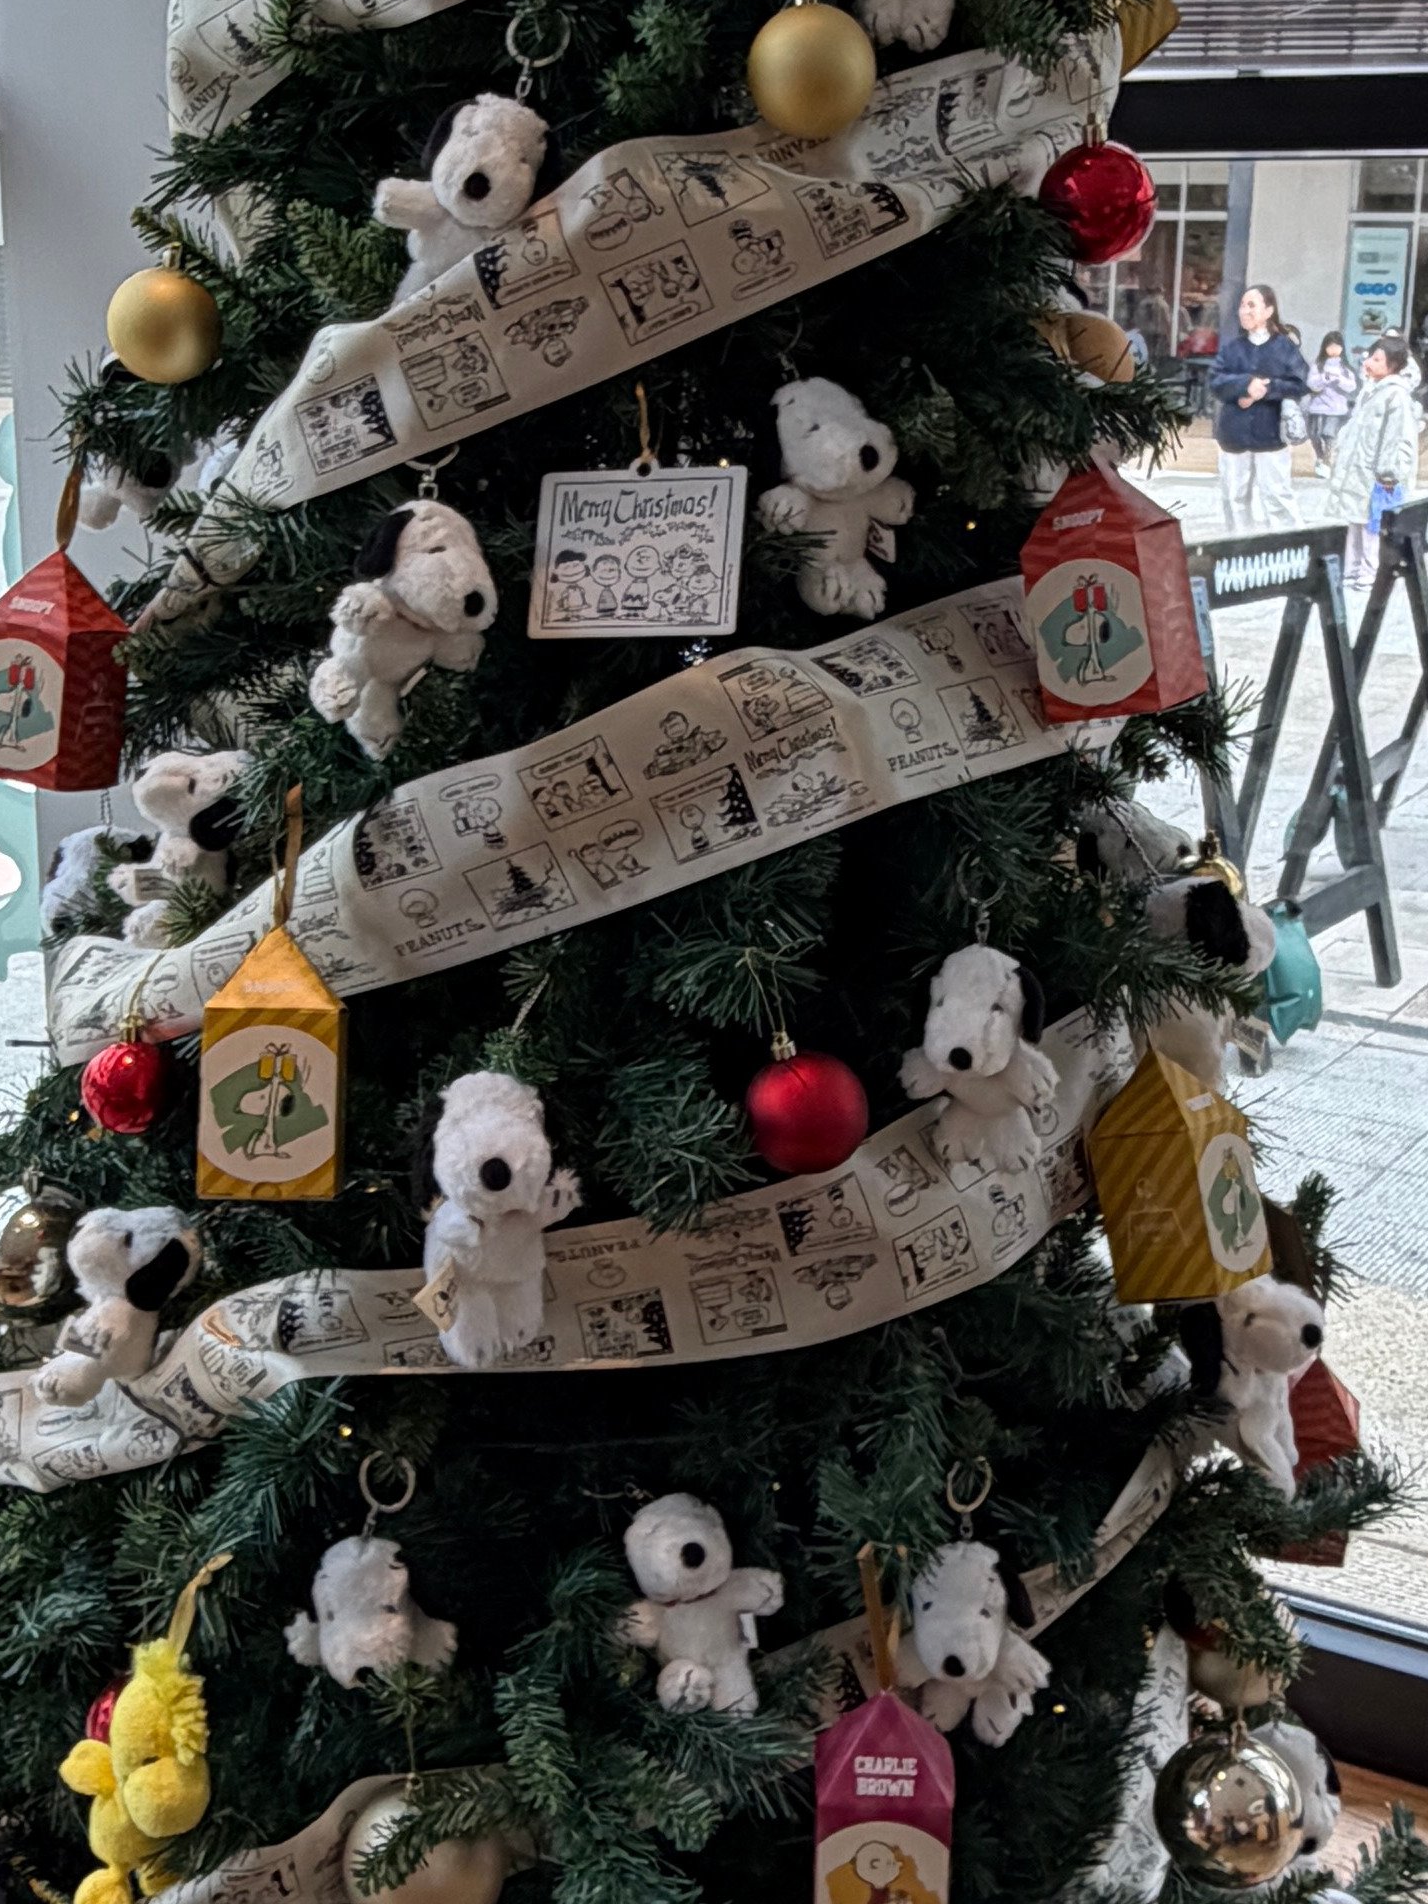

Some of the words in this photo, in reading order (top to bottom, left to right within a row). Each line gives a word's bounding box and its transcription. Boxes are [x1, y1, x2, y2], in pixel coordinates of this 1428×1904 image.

[559, 489, 612, 527] Merry
[613, 484, 719, 524] Christmas!
[886, 742, 959, 773] PEANUTS
[394, 918, 486, 957] PEANUTS
